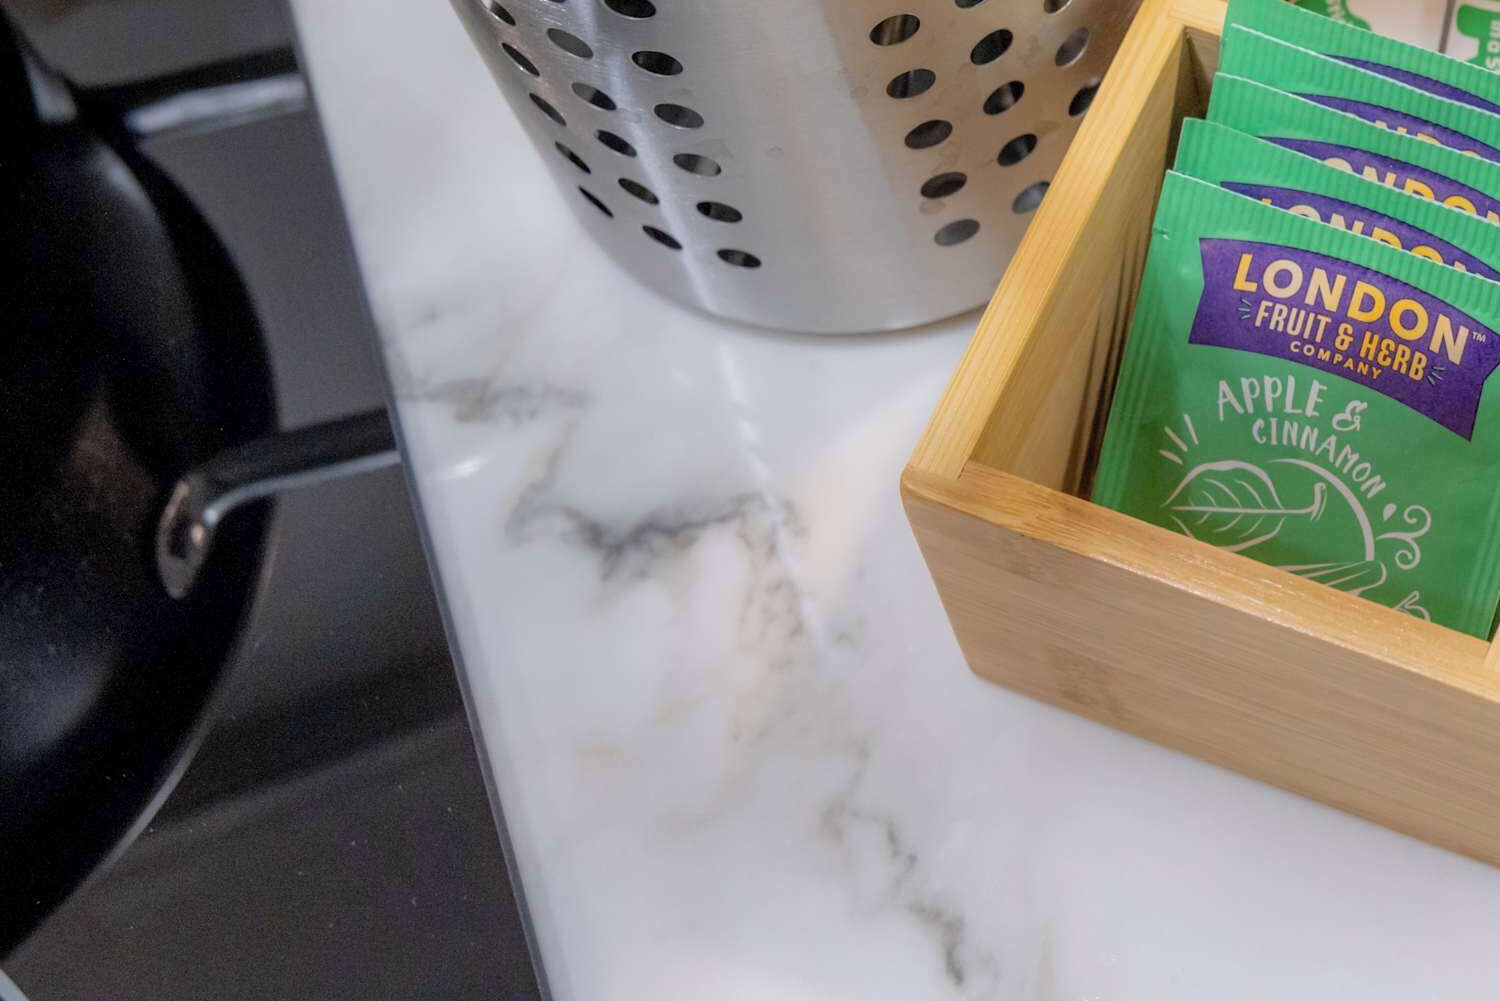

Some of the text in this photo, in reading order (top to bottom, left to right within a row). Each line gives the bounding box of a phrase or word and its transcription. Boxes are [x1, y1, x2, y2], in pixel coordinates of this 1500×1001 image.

[1232, 252, 1470, 367] LONDON
[1253, 299, 1430, 383] FRUIT & HERB
[1288, 339, 1384, 382] COMPANY
[1216, 373, 1369, 433] APPLE &
[1251, 416, 1388, 500] CINNAMON
